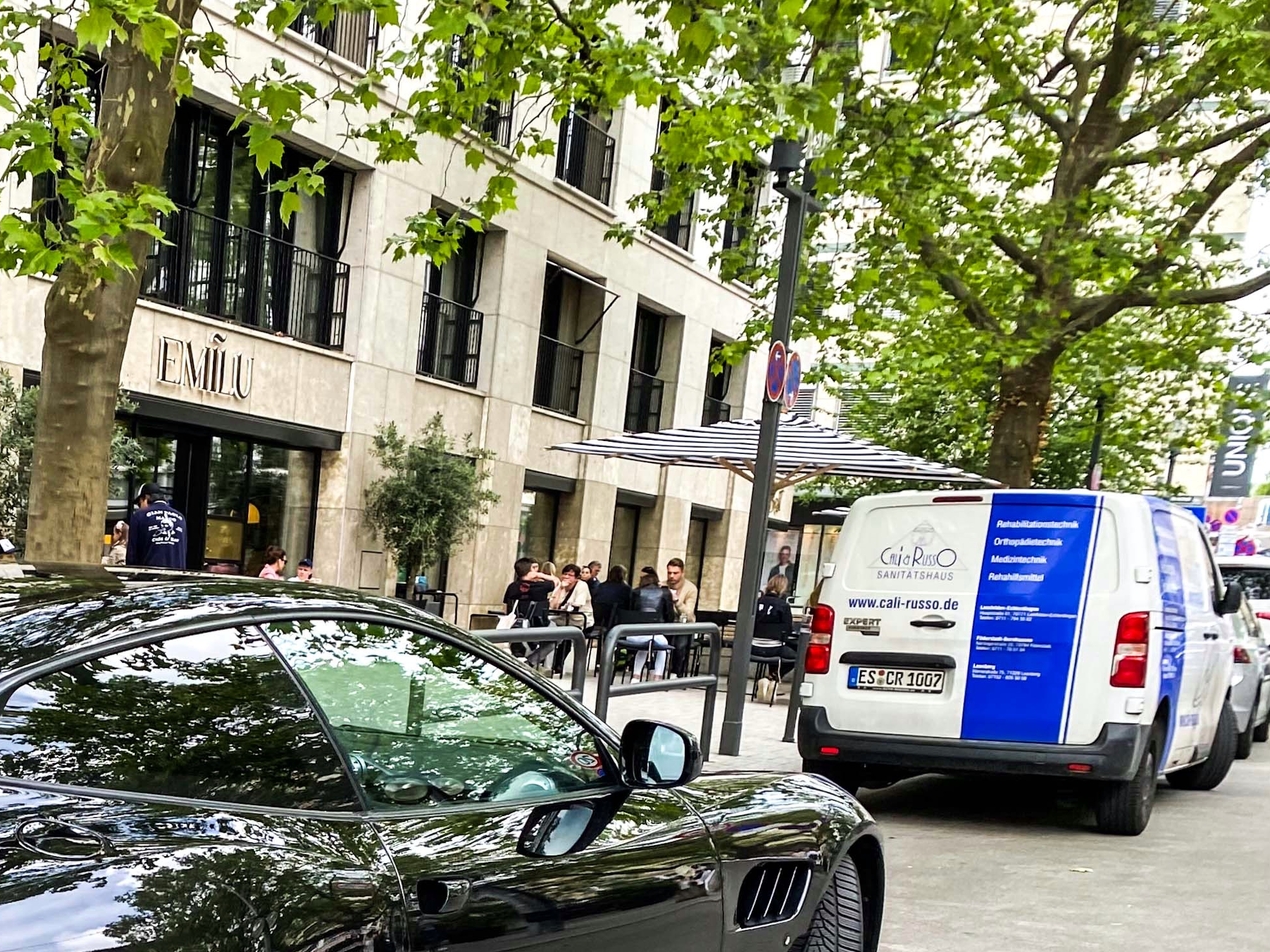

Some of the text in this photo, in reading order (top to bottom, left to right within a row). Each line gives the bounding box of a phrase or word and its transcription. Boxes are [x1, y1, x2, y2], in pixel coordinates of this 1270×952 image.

[848, 596, 959, 611] www.cali-russo.de
[843, 617, 882, 626] EXPERT
[858, 669, 942, 688] ES CR 1007
